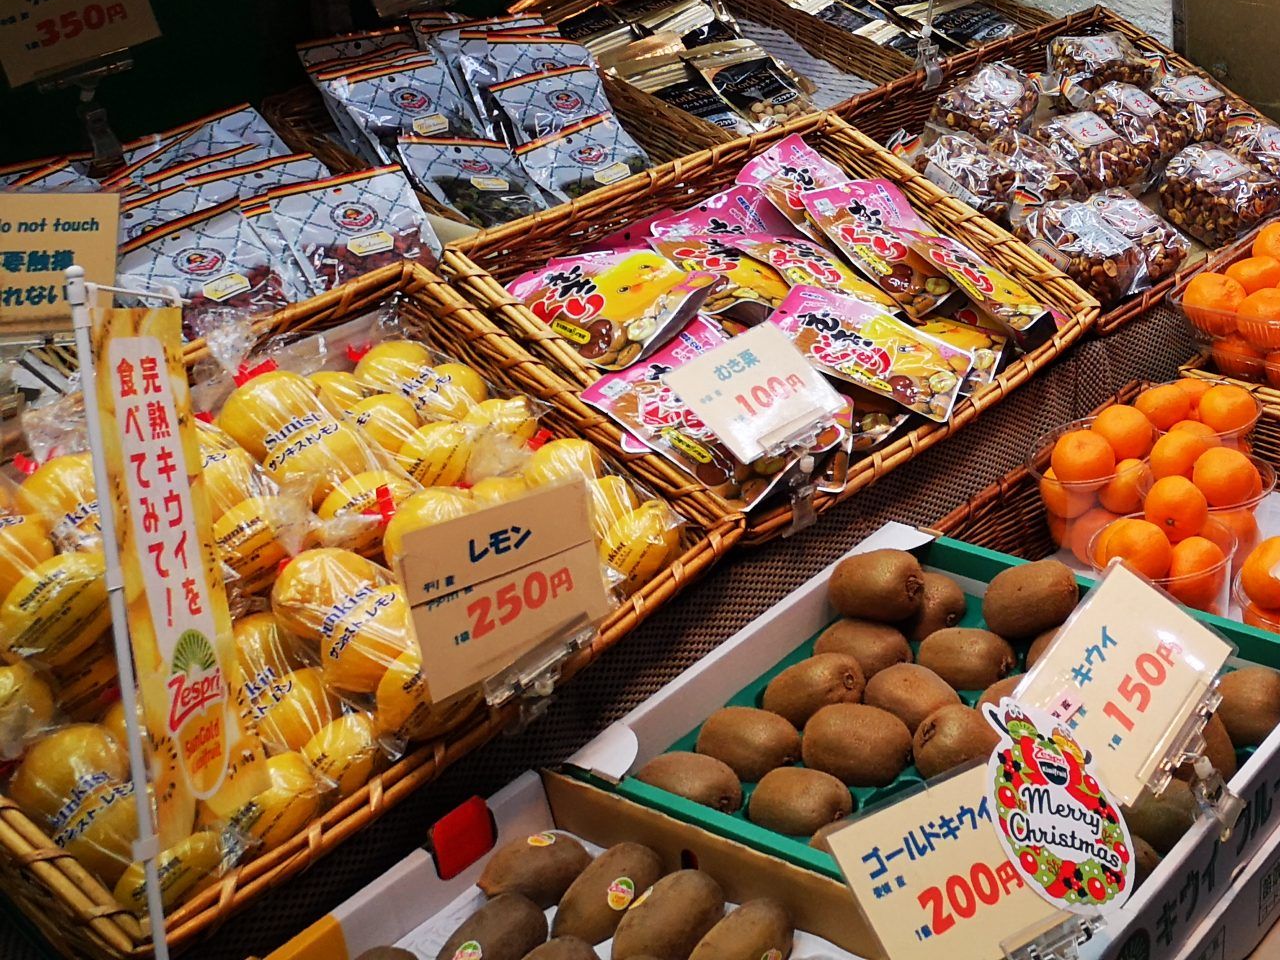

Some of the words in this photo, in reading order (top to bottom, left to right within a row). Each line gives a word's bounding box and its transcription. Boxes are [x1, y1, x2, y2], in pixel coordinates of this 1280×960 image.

[36, 2, 128, 48] 350円
[17, 217, 48, 233] not
[53, 217, 100, 233] touch
[713, 348, 761, 383] むき栗
[735, 372, 805, 417] 100円
[117, 358, 173, 628] 食べてみて!
[139, 356, 203, 616] 完熟キウイを
[469, 525, 532, 563] レモン
[467, 566, 574, 641] 250円
[1071, 625, 1118, 687] キウイ
[1103, 638, 1183, 733] 150円
[168, 668, 224, 732] Zespri
[1035, 744, 1066, 767] Zespri
[862, 796, 992, 880] ゴールドキウイ
[1009, 812, 1119, 869] Christmas
[1022, 787, 1101, 836] Merry
[917, 861, 1024, 935] 200円
